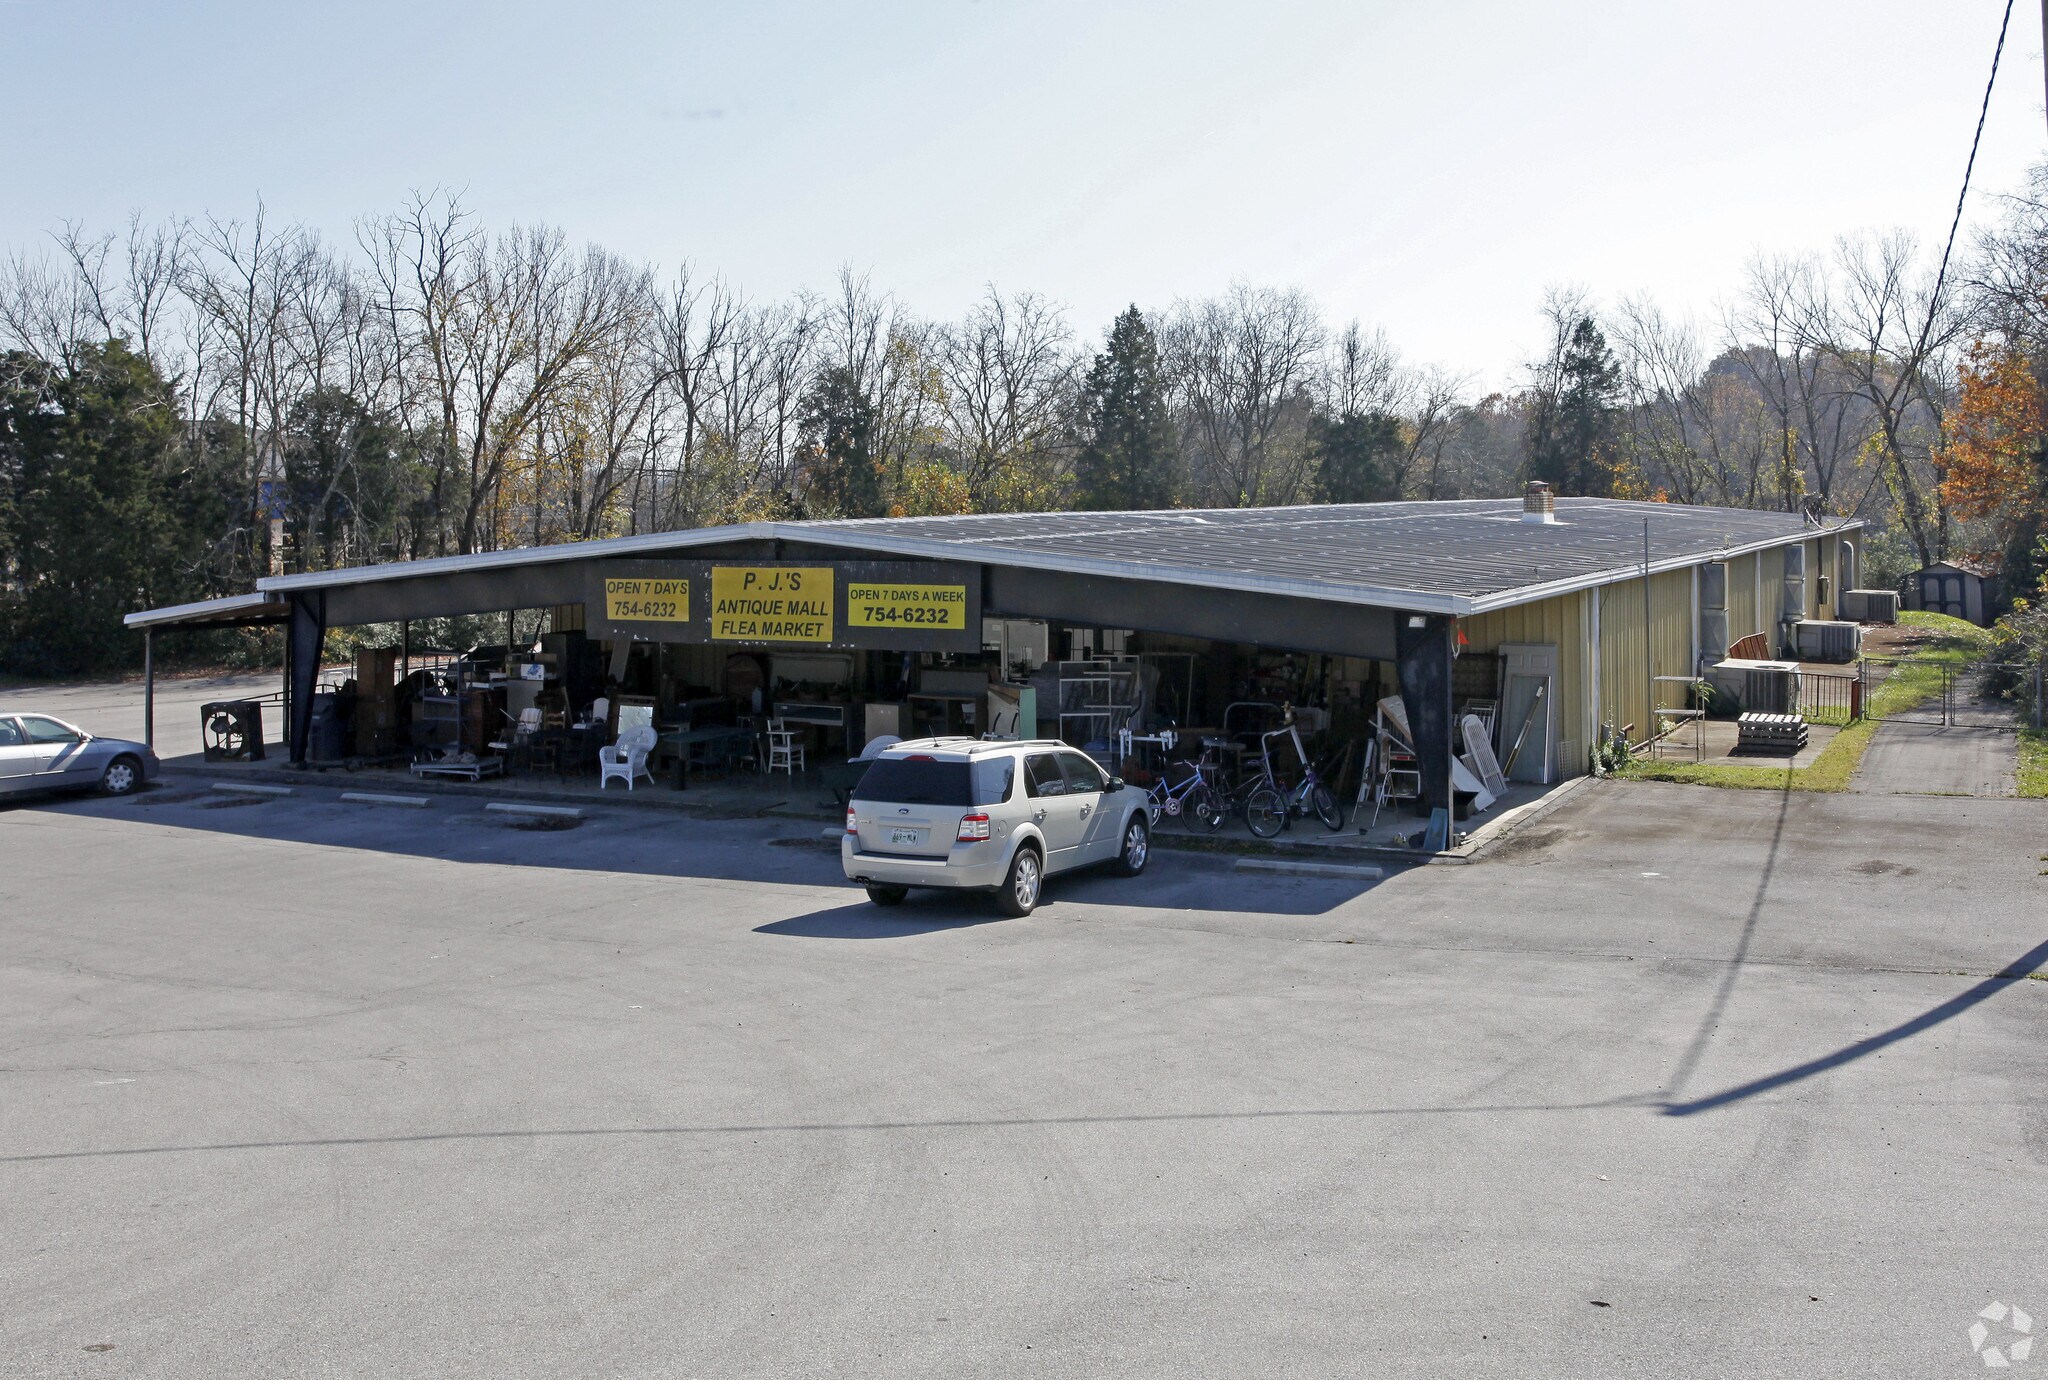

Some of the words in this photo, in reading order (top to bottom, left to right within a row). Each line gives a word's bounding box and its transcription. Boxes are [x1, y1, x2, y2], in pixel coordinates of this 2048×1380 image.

[607, 581, 641, 594] OPEN
[644, 582, 651, 594] 7
[654, 582, 688, 595] DAYS
[850, 589, 880, 600] OPEN
[883, 590, 889, 600] 7
[891, 590, 919, 601] DAYS
[922, 591, 930, 601] A
[932, 591, 964, 602] WEEK
[614, 601, 676, 617] 754-6232
[717, 599, 784, 616] ANTIQUE
[787, 601, 829, 616] MALL
[864, 606, 949, 624] 754-6232
[721, 621, 757, 636] FLEA
[761, 622, 824, 637] MARKET
